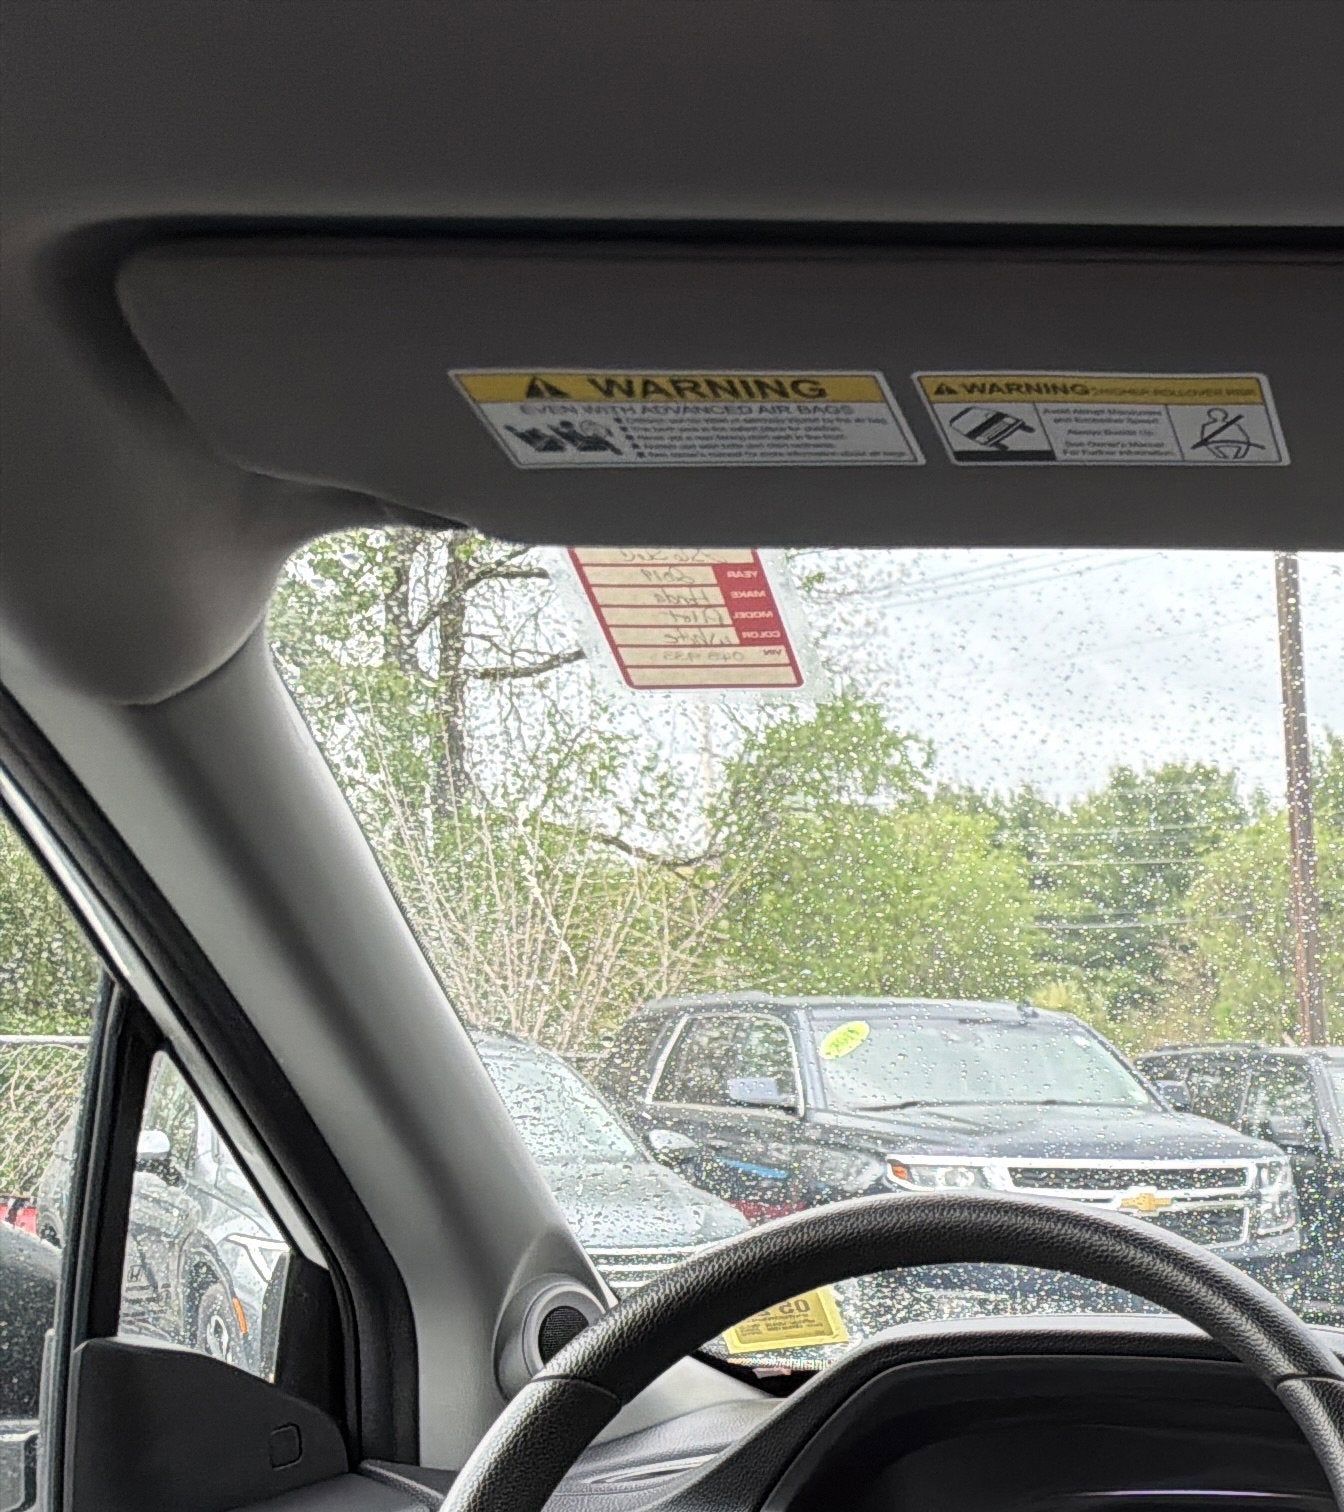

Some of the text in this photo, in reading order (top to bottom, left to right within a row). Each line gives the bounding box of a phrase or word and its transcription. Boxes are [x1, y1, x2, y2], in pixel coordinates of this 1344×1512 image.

[587, 377, 829, 399] WARNING
[963, 382, 1091, 395] WARNING
[520, 404, 856, 415] EVEN WITH ADVANCED AIR BAGS
